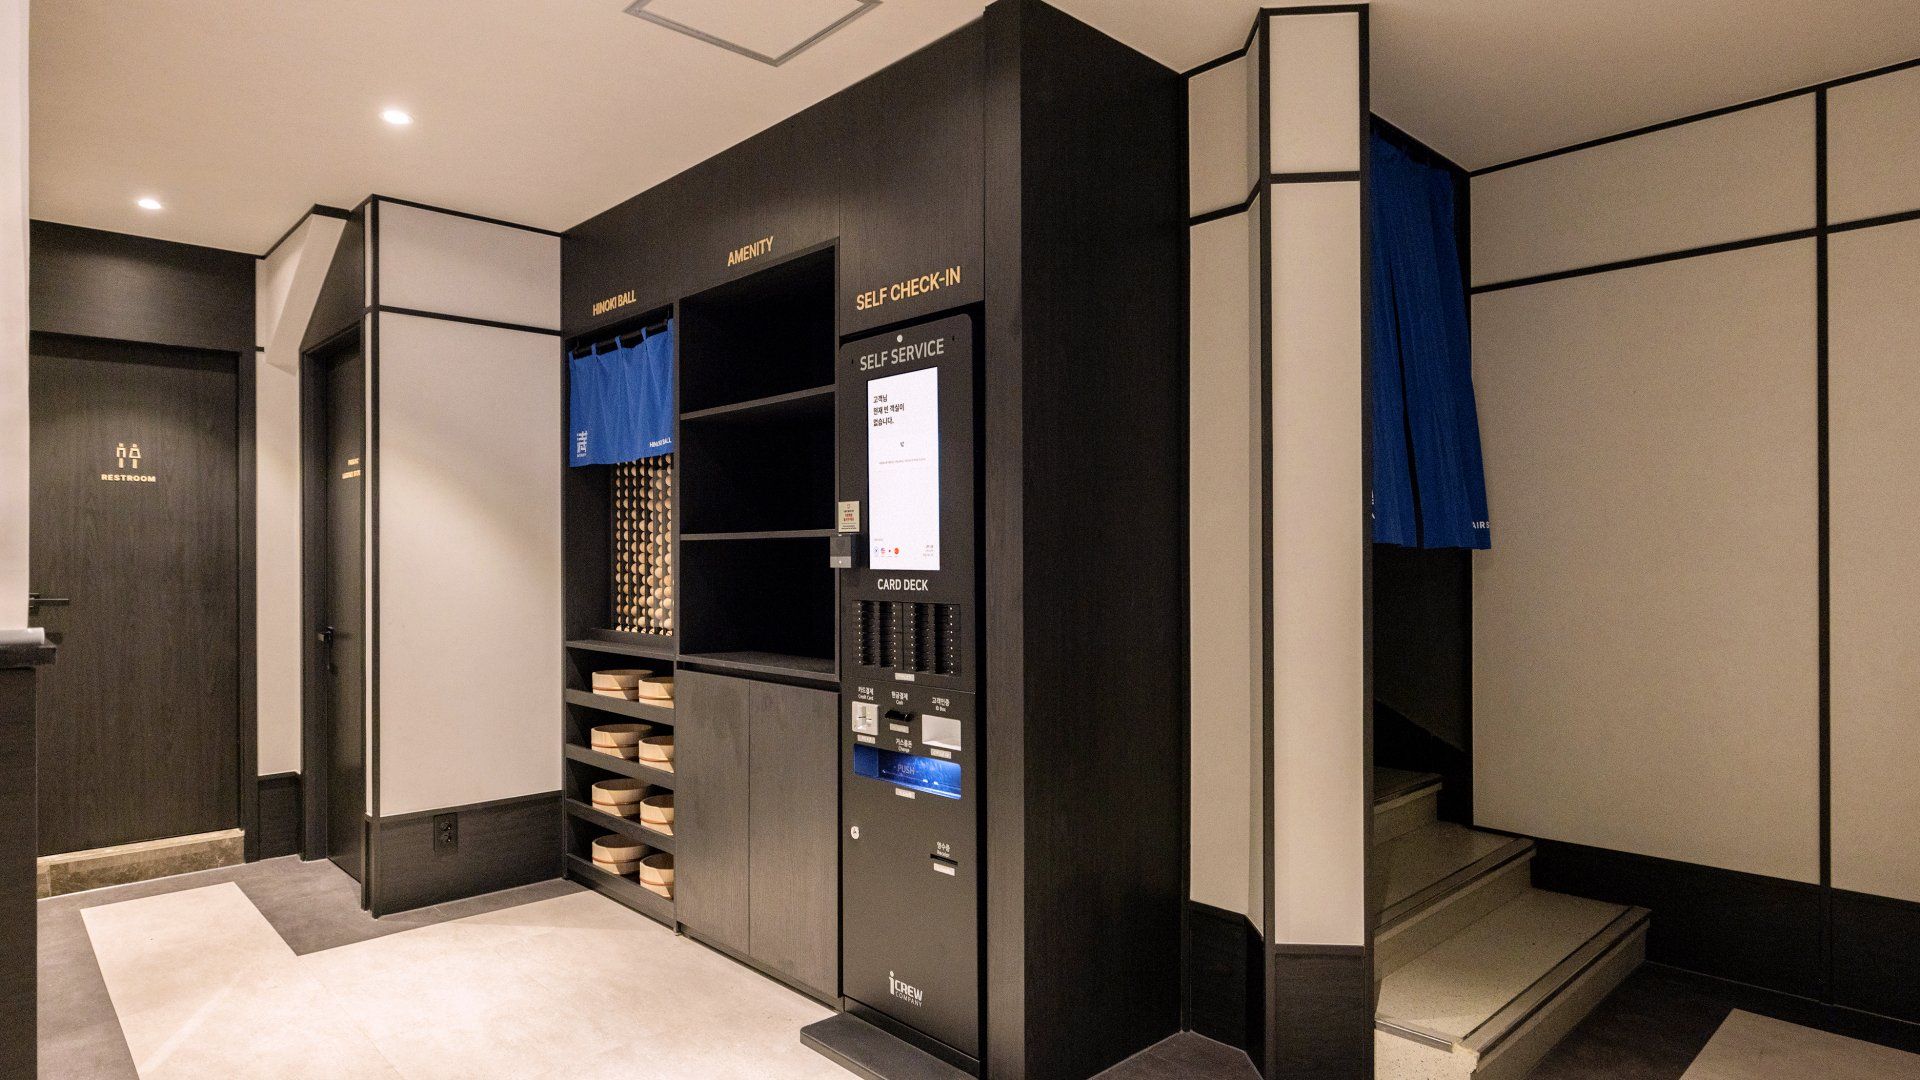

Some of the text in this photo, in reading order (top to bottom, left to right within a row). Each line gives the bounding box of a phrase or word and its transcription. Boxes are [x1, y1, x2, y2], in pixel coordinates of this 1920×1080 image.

[728, 237, 774, 266] AMENITY
[856, 265, 961, 312] SELF CHECK-IN
[592, 290, 636, 317] HINOKI BALL
[860, 338, 944, 371] SELF SERVICE
[873, 394, 888, 404] 고객님
[101, 473, 157, 483] RESTROOM
[877, 578, 928, 592] CARD DECK
[895, 990, 923, 1008] COMPANY
